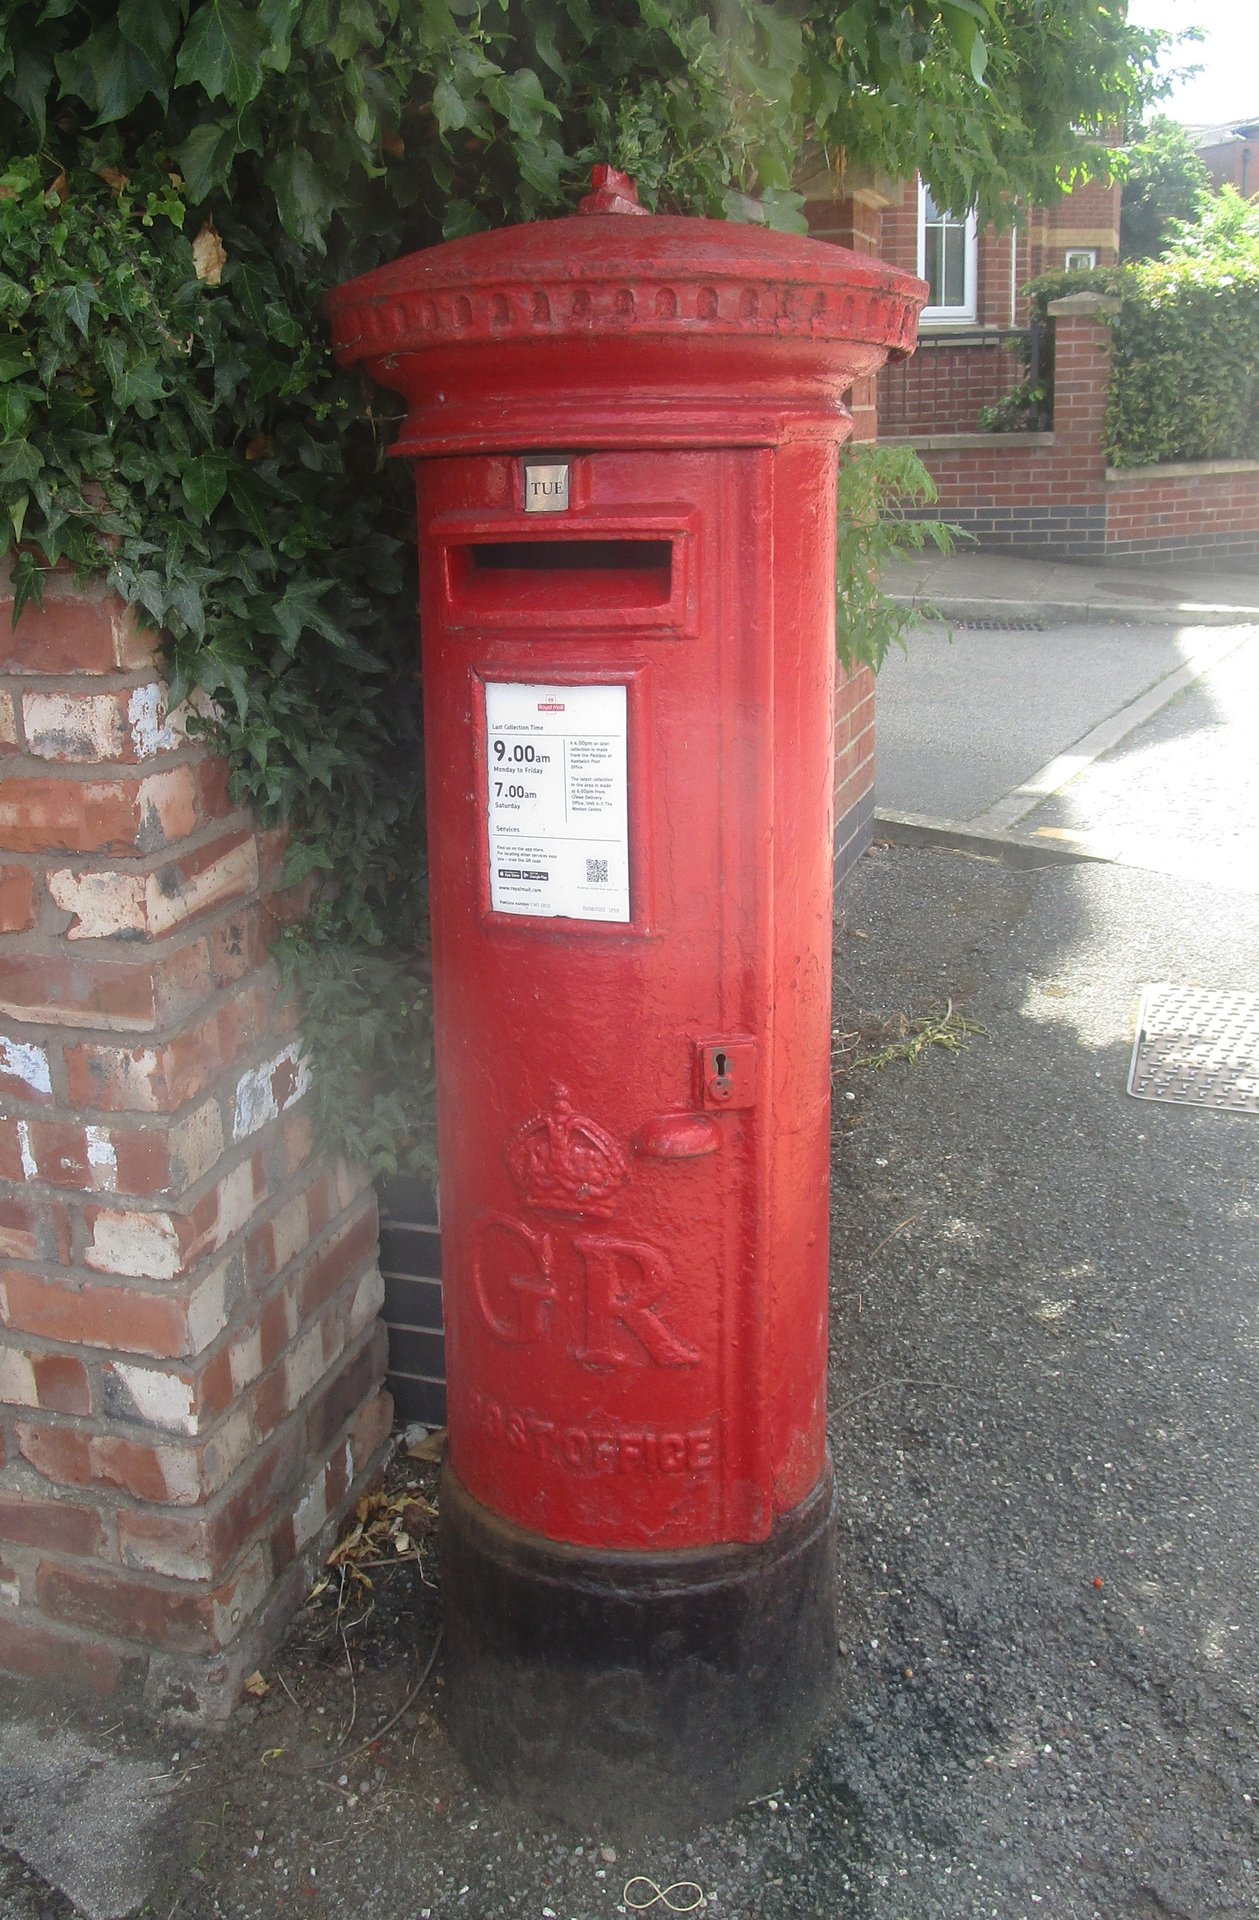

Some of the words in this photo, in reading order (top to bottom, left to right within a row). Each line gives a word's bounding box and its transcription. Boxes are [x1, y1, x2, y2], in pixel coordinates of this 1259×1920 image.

[531, 482, 564, 495] TUE
[494, 740, 551, 763] 9.00am
[494, 782, 537, 799] 7.00am
[495, 802, 520, 810] Saturday
[470, 1393, 554, 1459] OST
[563, 1424, 714, 1474] OFFICE
